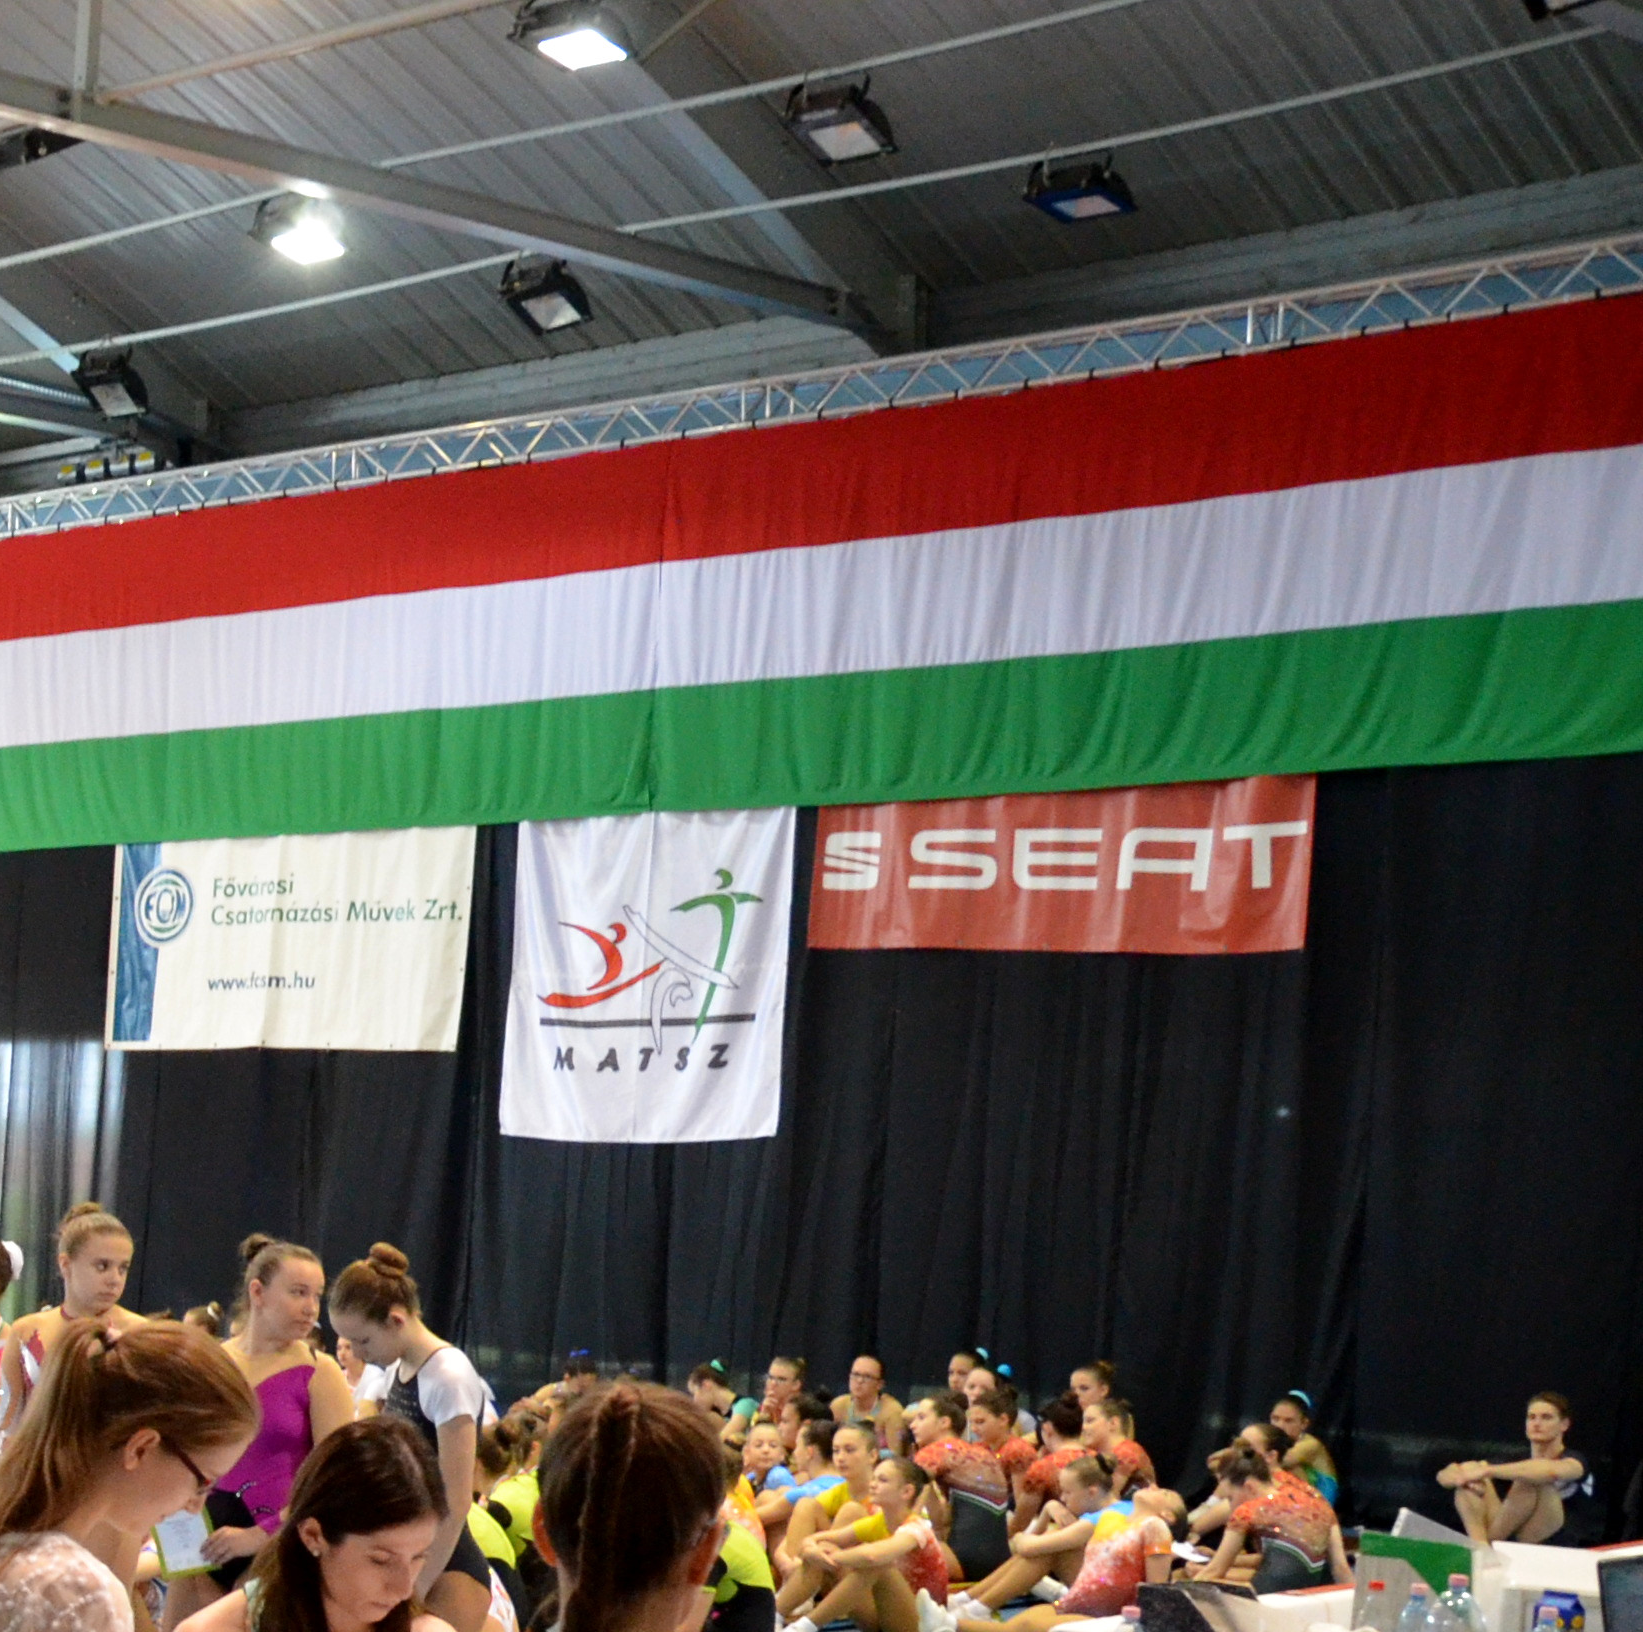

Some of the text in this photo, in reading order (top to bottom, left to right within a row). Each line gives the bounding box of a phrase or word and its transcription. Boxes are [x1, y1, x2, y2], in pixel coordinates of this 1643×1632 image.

[907, 819, 1309, 893] SEAT
[212, 872, 295, 898] Fővárosi
[210, 902, 339, 926] Csatornázási
[423, 898, 463, 922] Zrt.
[553, 1042, 730, 1073] MATSZ
